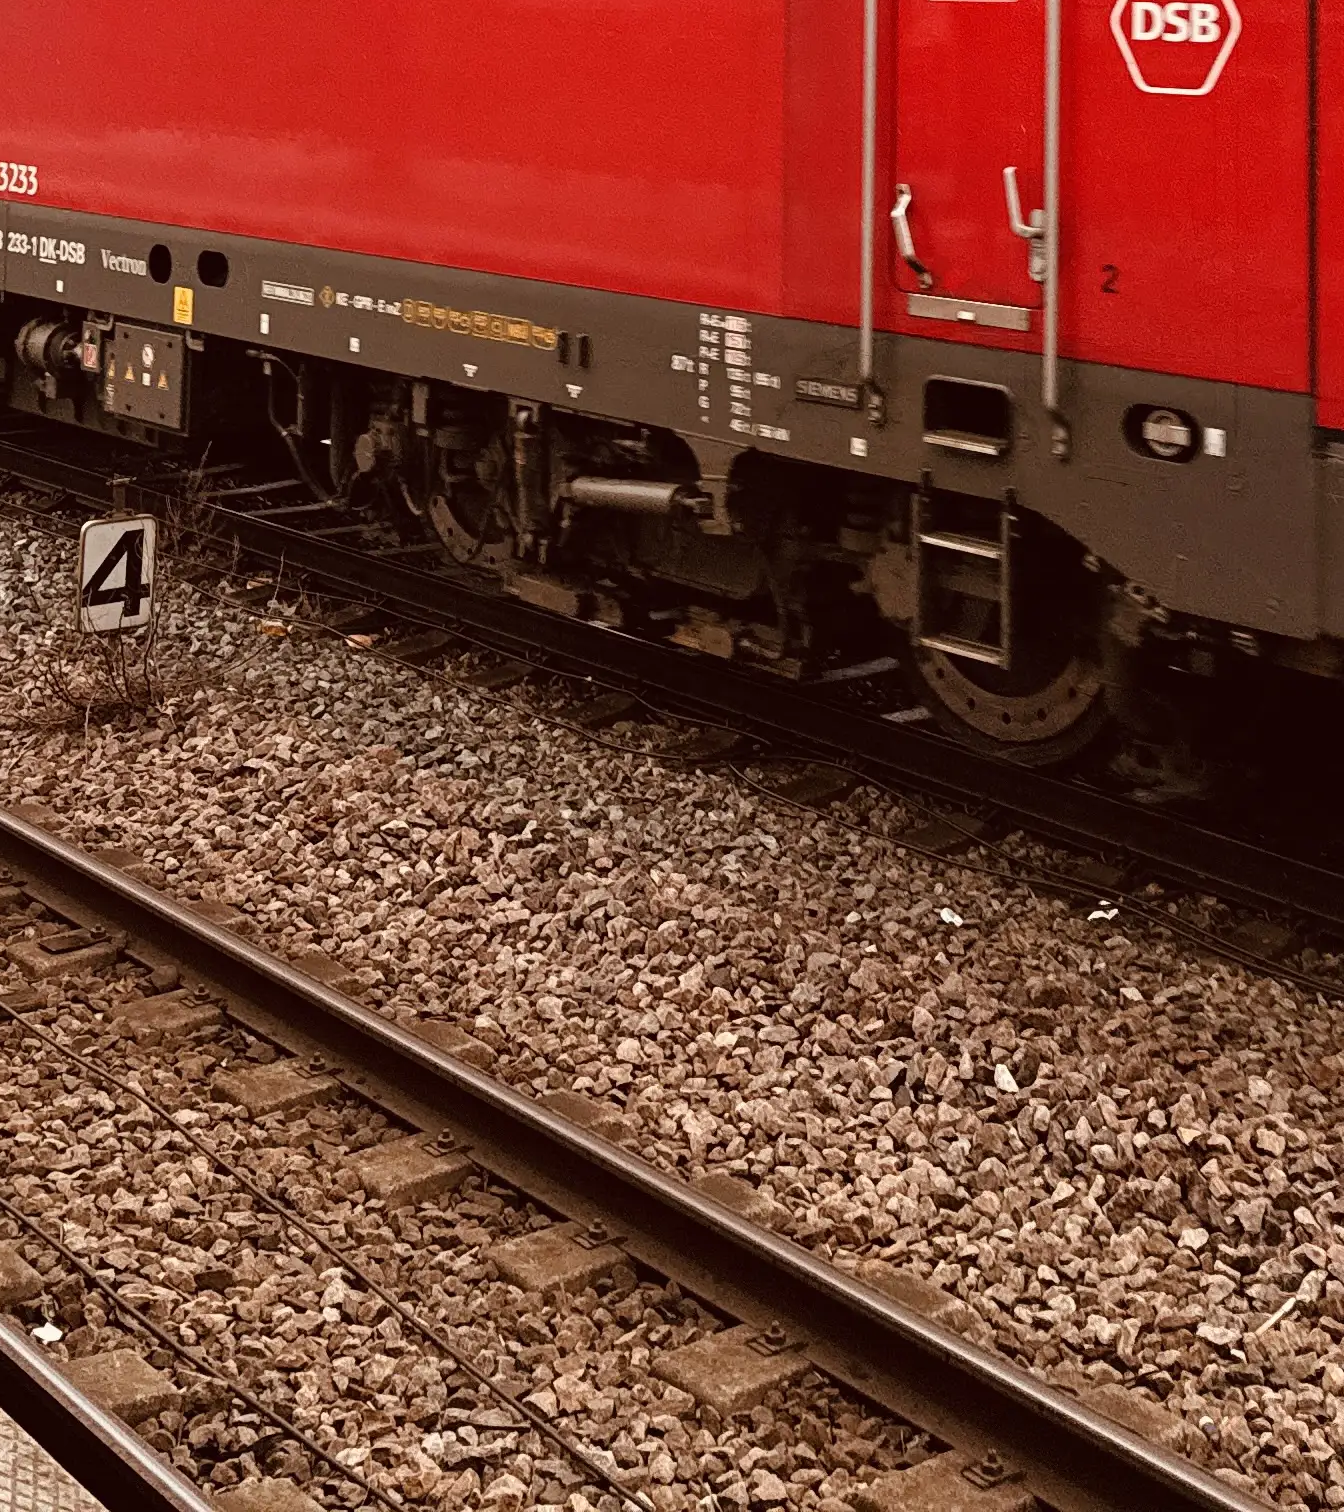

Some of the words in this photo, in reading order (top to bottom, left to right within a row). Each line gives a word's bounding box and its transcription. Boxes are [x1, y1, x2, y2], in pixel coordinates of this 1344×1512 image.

[1131, 1, 1221, 43] DSB
[7, 231, 38, 257] 233-1
[39, 236, 86, 265] DK-DSB
[100, 248, 148, 276] Vectron
[1101, 264, 1120, 294] 2
[81, 528, 151, 617] 4
